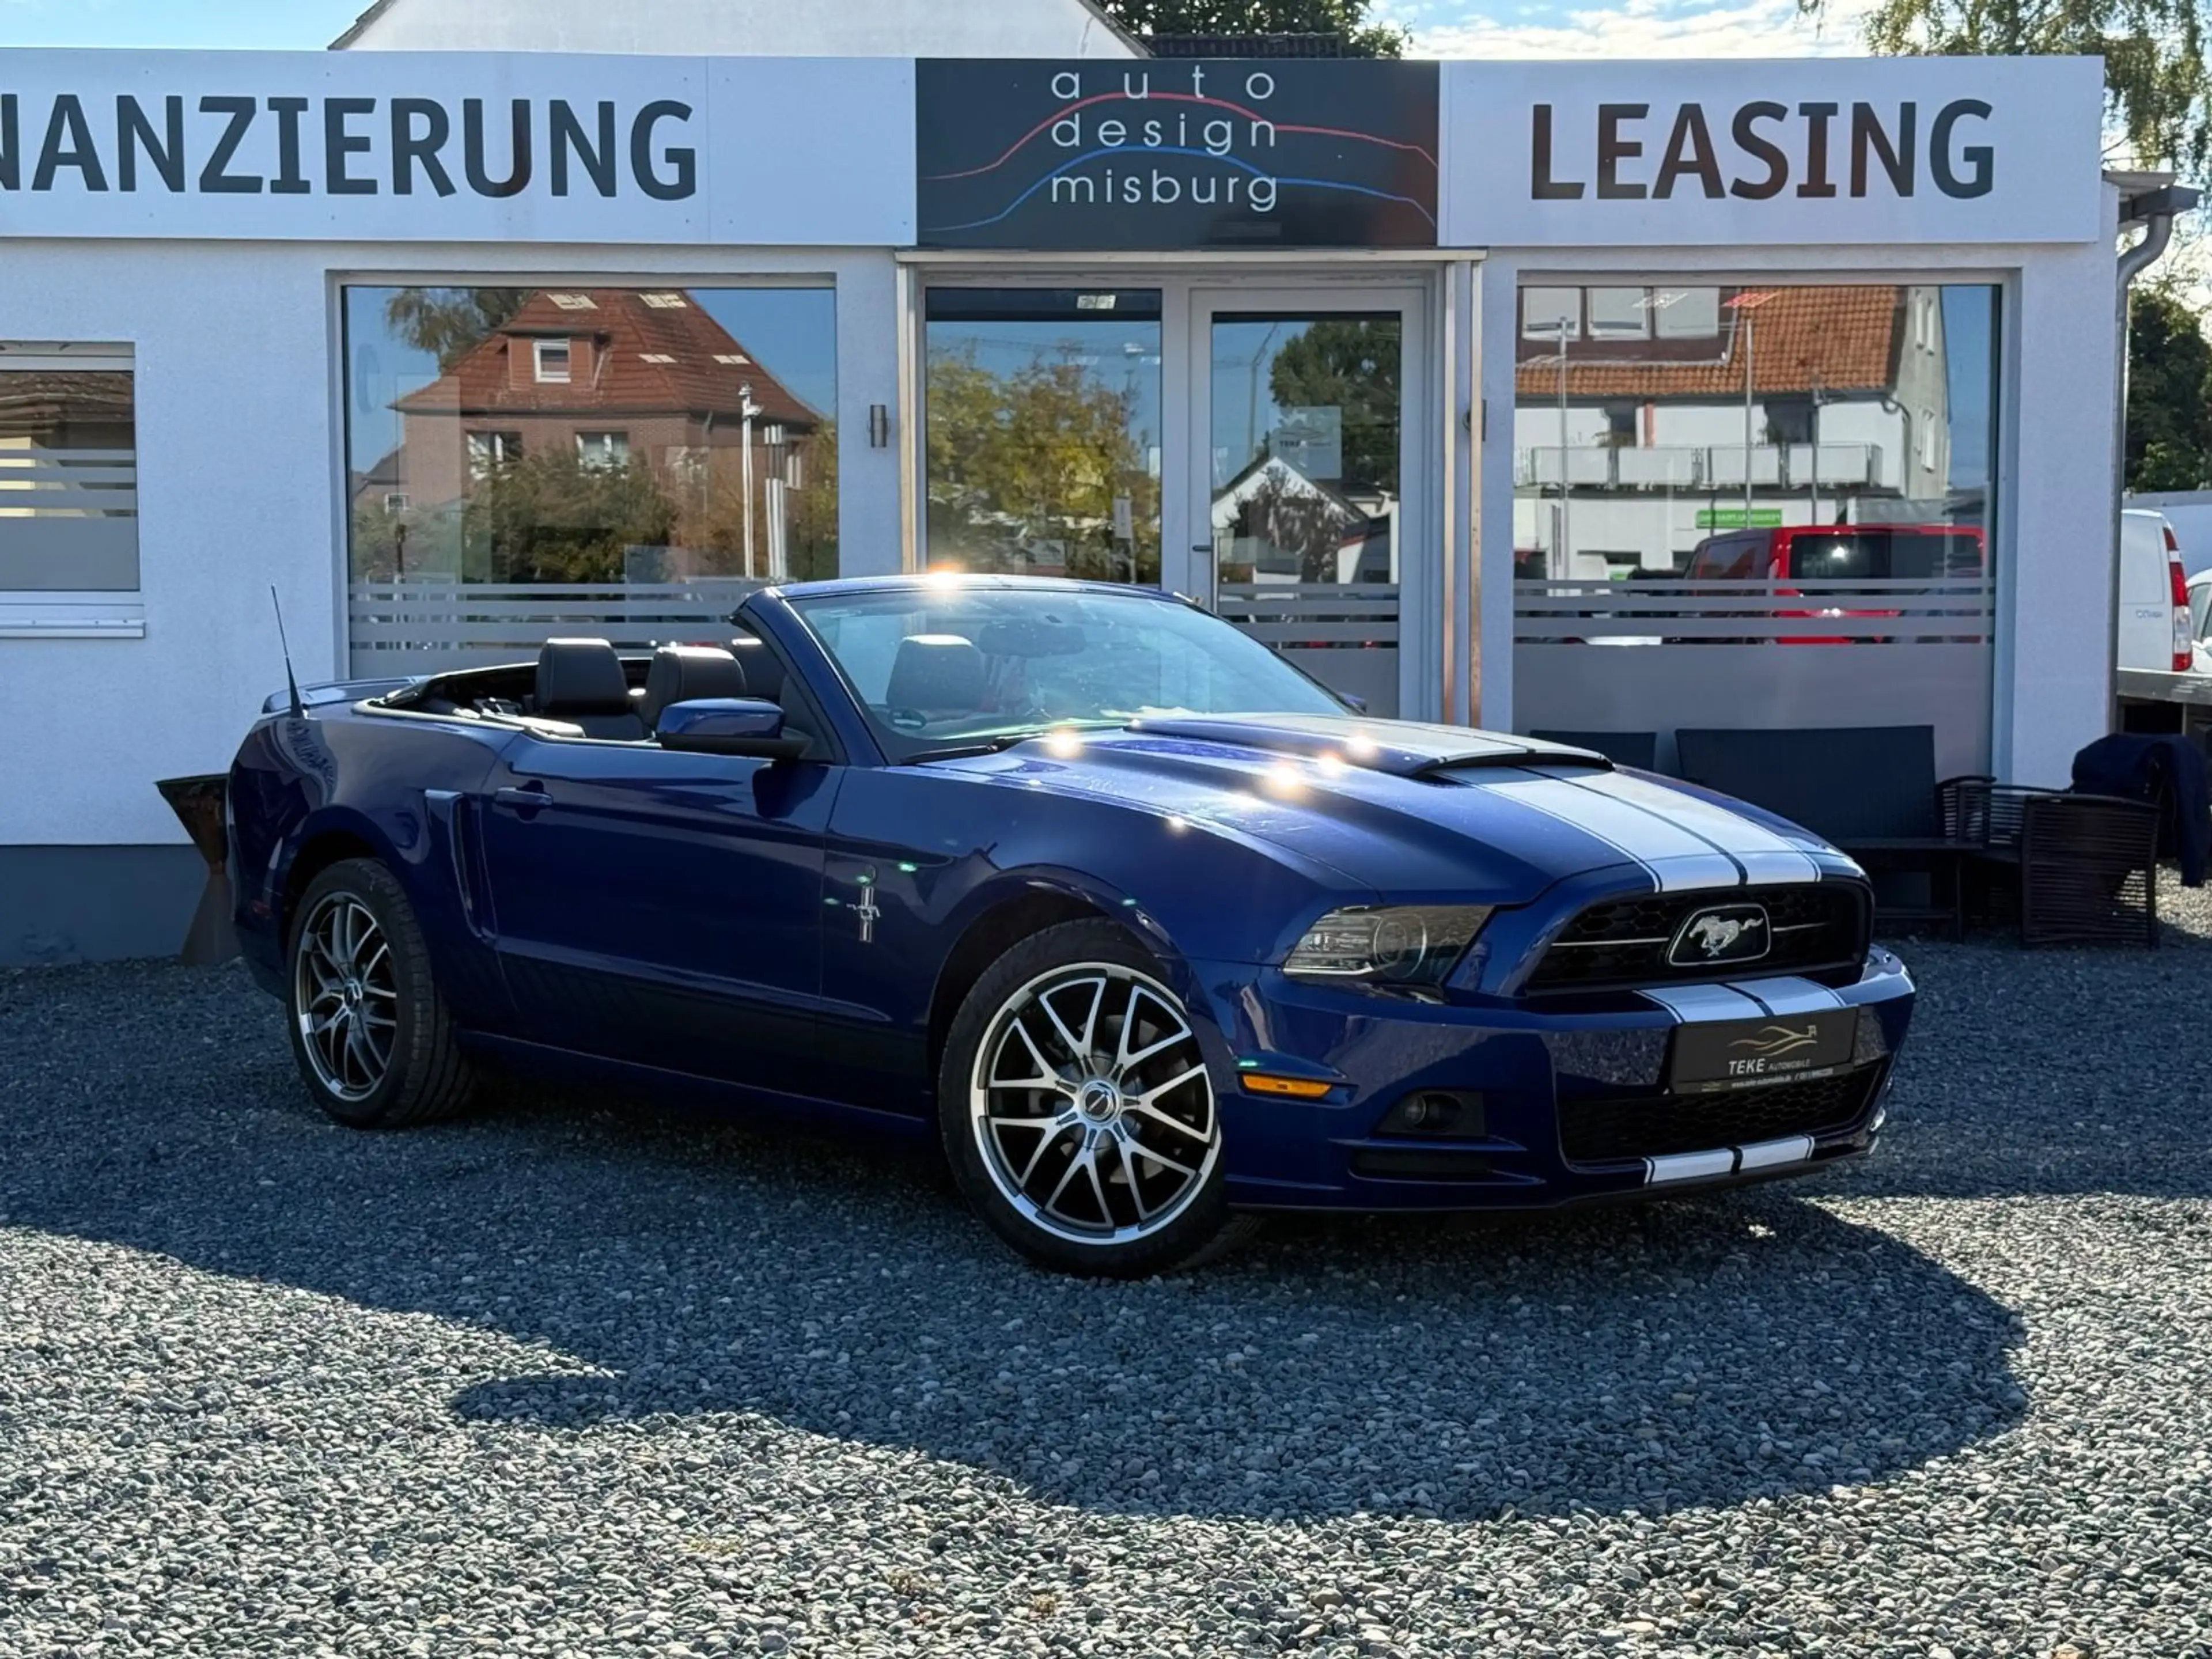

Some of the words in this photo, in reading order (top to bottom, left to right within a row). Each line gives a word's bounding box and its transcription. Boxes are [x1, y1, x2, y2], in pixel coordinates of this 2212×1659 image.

[1051, 65, 1275, 100] auto
[1051, 112, 1275, 156] design
[1531, 98, 1994, 200] LEASING
[1051, 169, 1277, 213] misburg
[1729, 1058, 1766, 1075] TEKE
